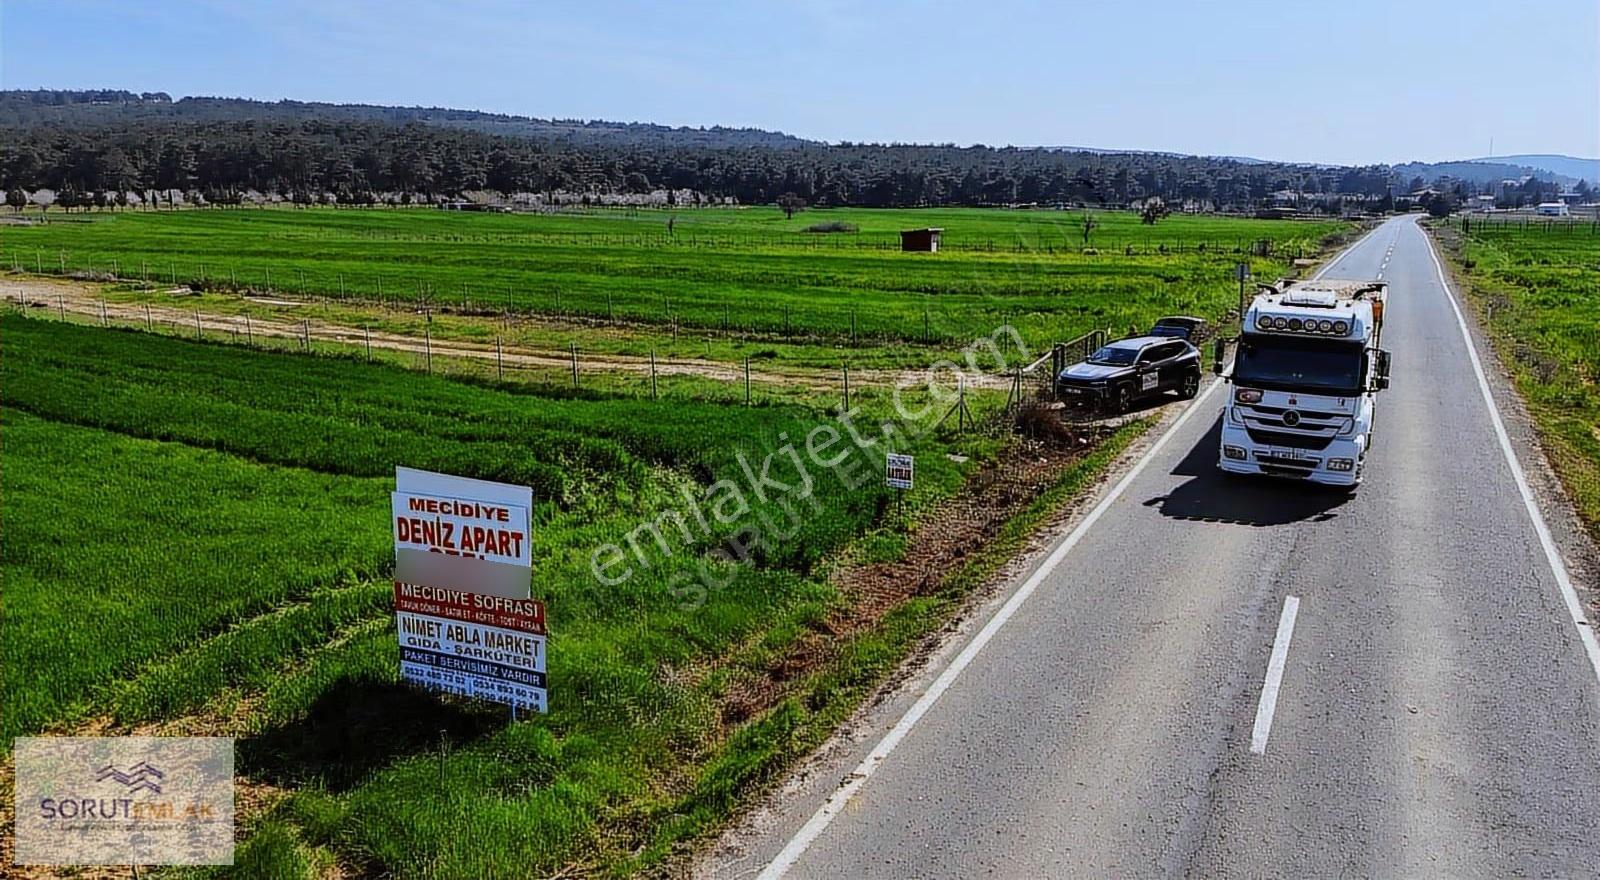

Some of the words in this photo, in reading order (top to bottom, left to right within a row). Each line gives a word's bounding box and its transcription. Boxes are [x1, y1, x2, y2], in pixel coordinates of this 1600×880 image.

[409, 498, 509, 522] MECİDİYE
[397, 516, 455, 549] DENİZ
[461, 525, 523, 558] APART
[474, 595, 538, 618] SOFRASI
[402, 615, 443, 639] NİMET
[446, 624, 481, 645] ABLA
[484, 631, 540, 657] MARKET
[407, 637, 441, 650] GIDA
[454, 644, 537, 669] SARKÜTERİ
[404, 650, 437, 664] PAKET
[500, 668, 541, 686] VARDIR
